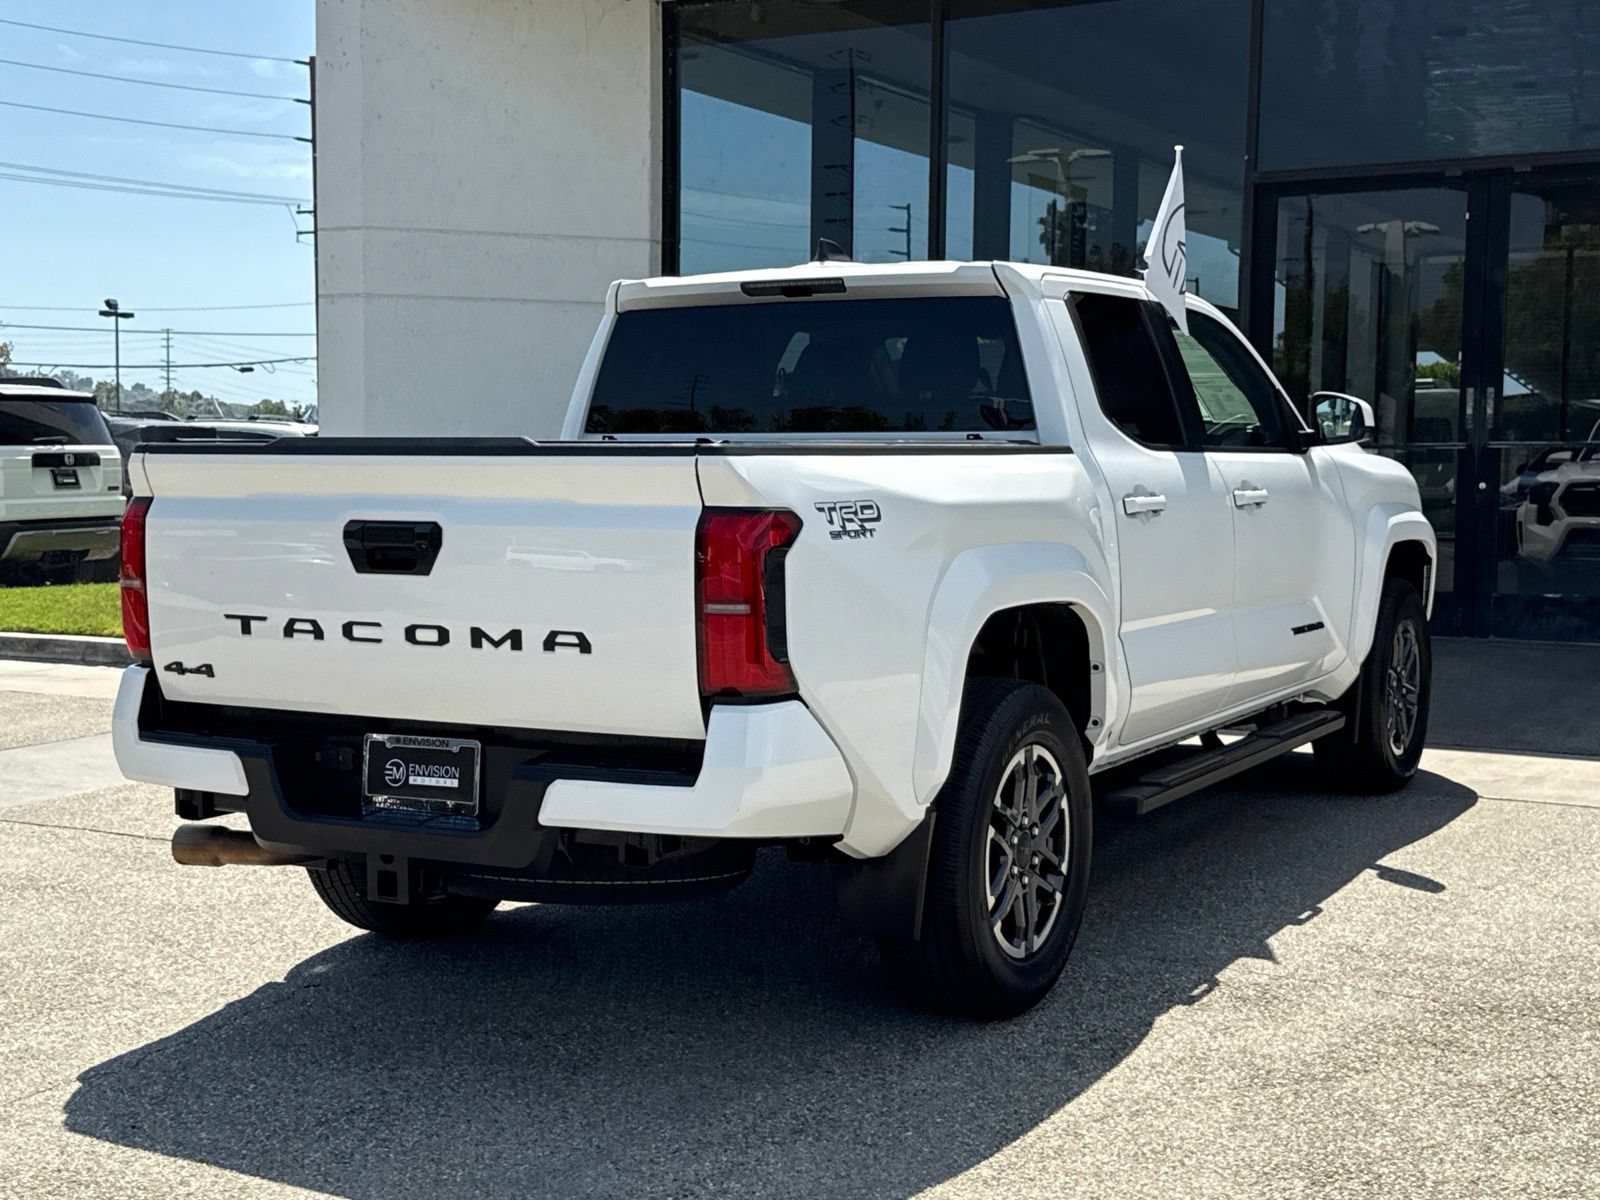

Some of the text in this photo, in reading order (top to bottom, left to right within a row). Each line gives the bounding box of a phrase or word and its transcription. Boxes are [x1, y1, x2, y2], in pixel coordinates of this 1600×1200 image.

[814, 499, 882, 530] TRD
[829, 528, 877, 541] SPORT
[223, 613, 592, 655] TACOMA
[402, 736, 450, 748] ENVISION
[408, 763, 460, 778] ENVISION
[411, 777, 455, 786] MOTORS
